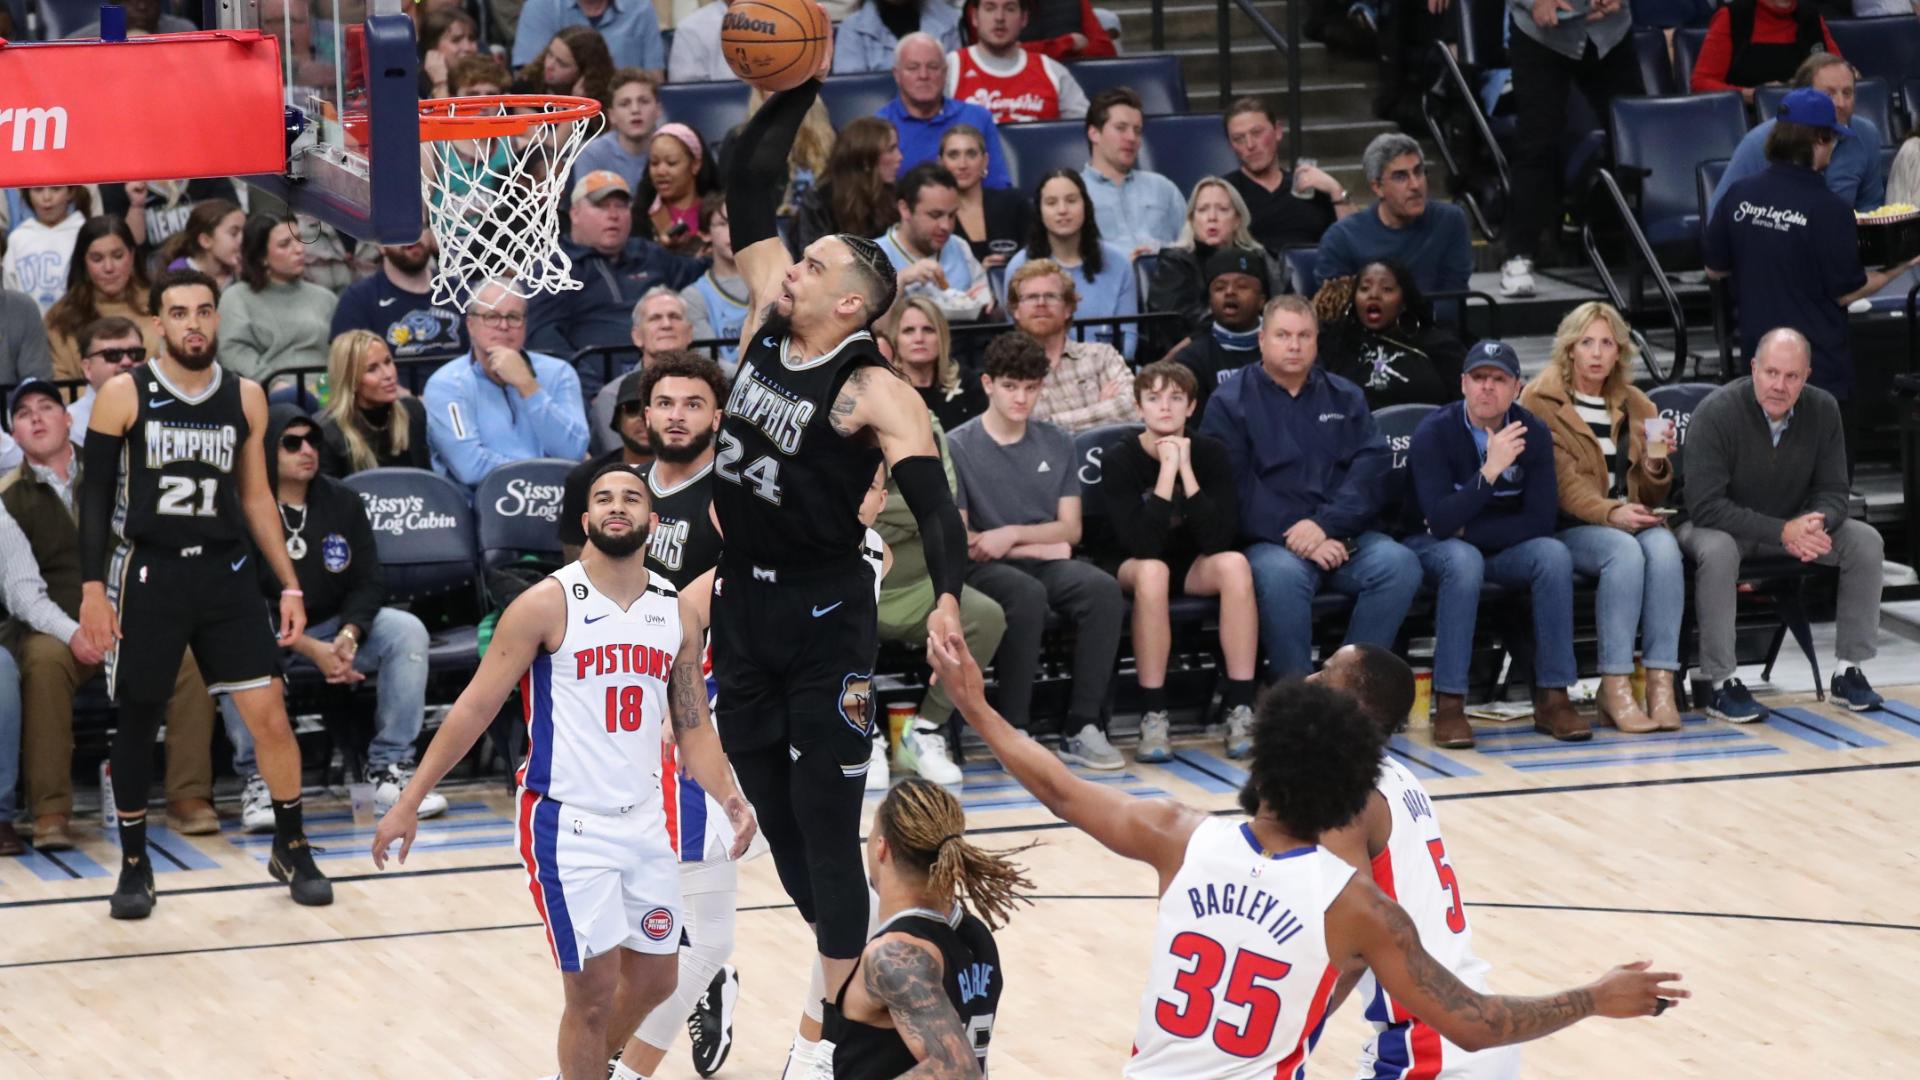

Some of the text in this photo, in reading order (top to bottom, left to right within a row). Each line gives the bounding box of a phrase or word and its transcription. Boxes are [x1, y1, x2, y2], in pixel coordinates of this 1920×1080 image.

[725, 360, 816, 456] MEMPHIS
[145, 420, 237, 473] MEMPHIS
[714, 428, 783, 506] 24
[157, 476, 218, 517] 21
[526, 499, 557, 522] Log
[372, 511, 457, 536] Log Cabin
[574, 586, 586, 597] 6
[645, 614, 666, 625] UWM
[574, 643, 673, 684] PISTONS
[605, 685, 644, 733] 18
[1426, 837, 1466, 934] 5
[1188, 883, 1304, 946] BAGLEY III
[1154, 931, 1292, 1058] 35
